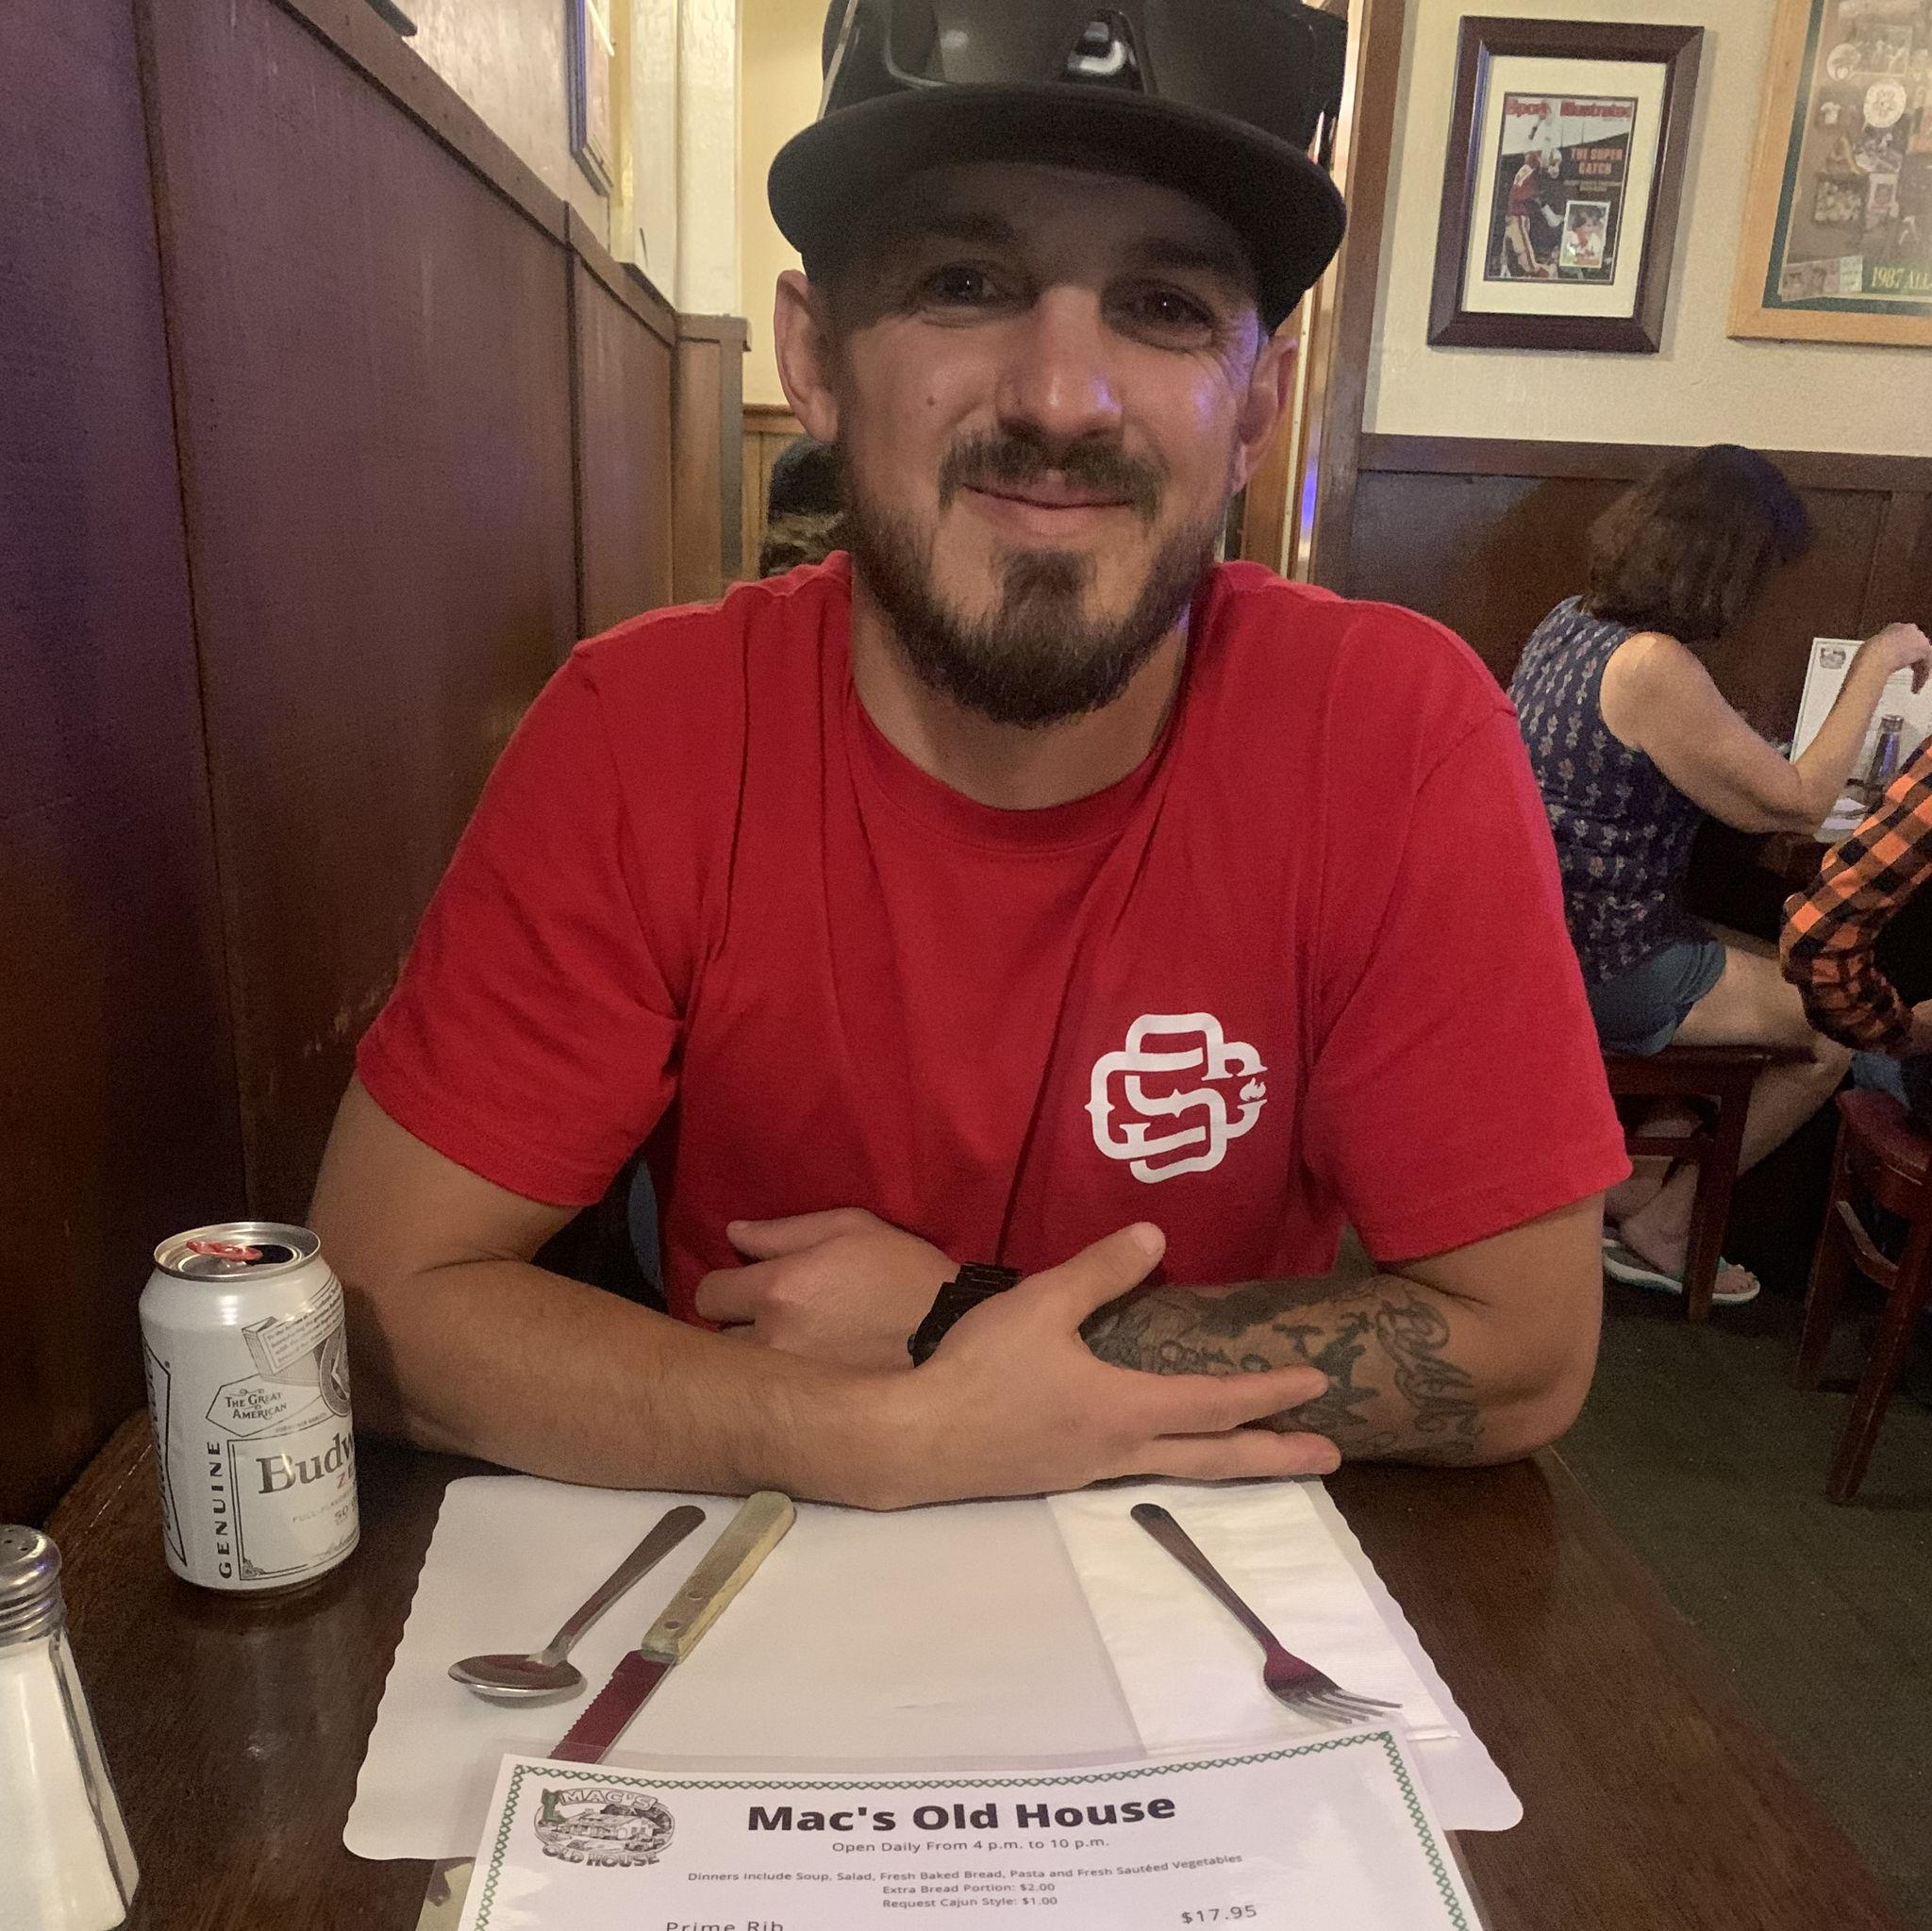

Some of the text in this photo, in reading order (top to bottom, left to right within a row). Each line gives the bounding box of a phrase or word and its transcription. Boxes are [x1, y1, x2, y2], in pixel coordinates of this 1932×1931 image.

[1591, 148, 1624, 161] SUPER
[1578, 162, 1612, 175] CATCH
[1871, 266, 1904, 289] 1987
[225, 1391, 282, 1408] THE GREAT
[232, 1402, 288, 1420] AMERICAN
[208, 1442, 232, 1578] GENUINE
[559, 1789, 658, 1812] MAC'S
[747, 1797, 1176, 1832] Mac's Old House
[832, 1837, 1109, 1854] Open Daily From 4 p.m. to 10 p.m.
[541, 1844, 660, 1868] OLD HOUSE
[688, 1872, 740, 1881] Dinners
[743, 1872, 792, 1881] Include
[837, 1872, 876, 1882] Salad,
[880, 1871, 916, 1881] Fresh
[920, 1870, 960, 1880] Baked
[964, 1869, 1007, 1880] Bread,
[1010, 1869, 1046, 1879] Pasta
[1049, 1869, 1074, 1878] and
[1077, 1867, 1113, 1877] Fresh
[1116, 1862, 1170, 1875] Sautéed
[1172, 1853, 1243, 1871] Vegetables
[883, 1882, 1056, 1895] Extra Bread Portion: $2.00
[883, 1896, 1058, 1910] Request Cajun Style: $1.00
[1181, 1904, 1257, 1924] $17.95
[666, 1921, 784, 1931] Prime Rib
